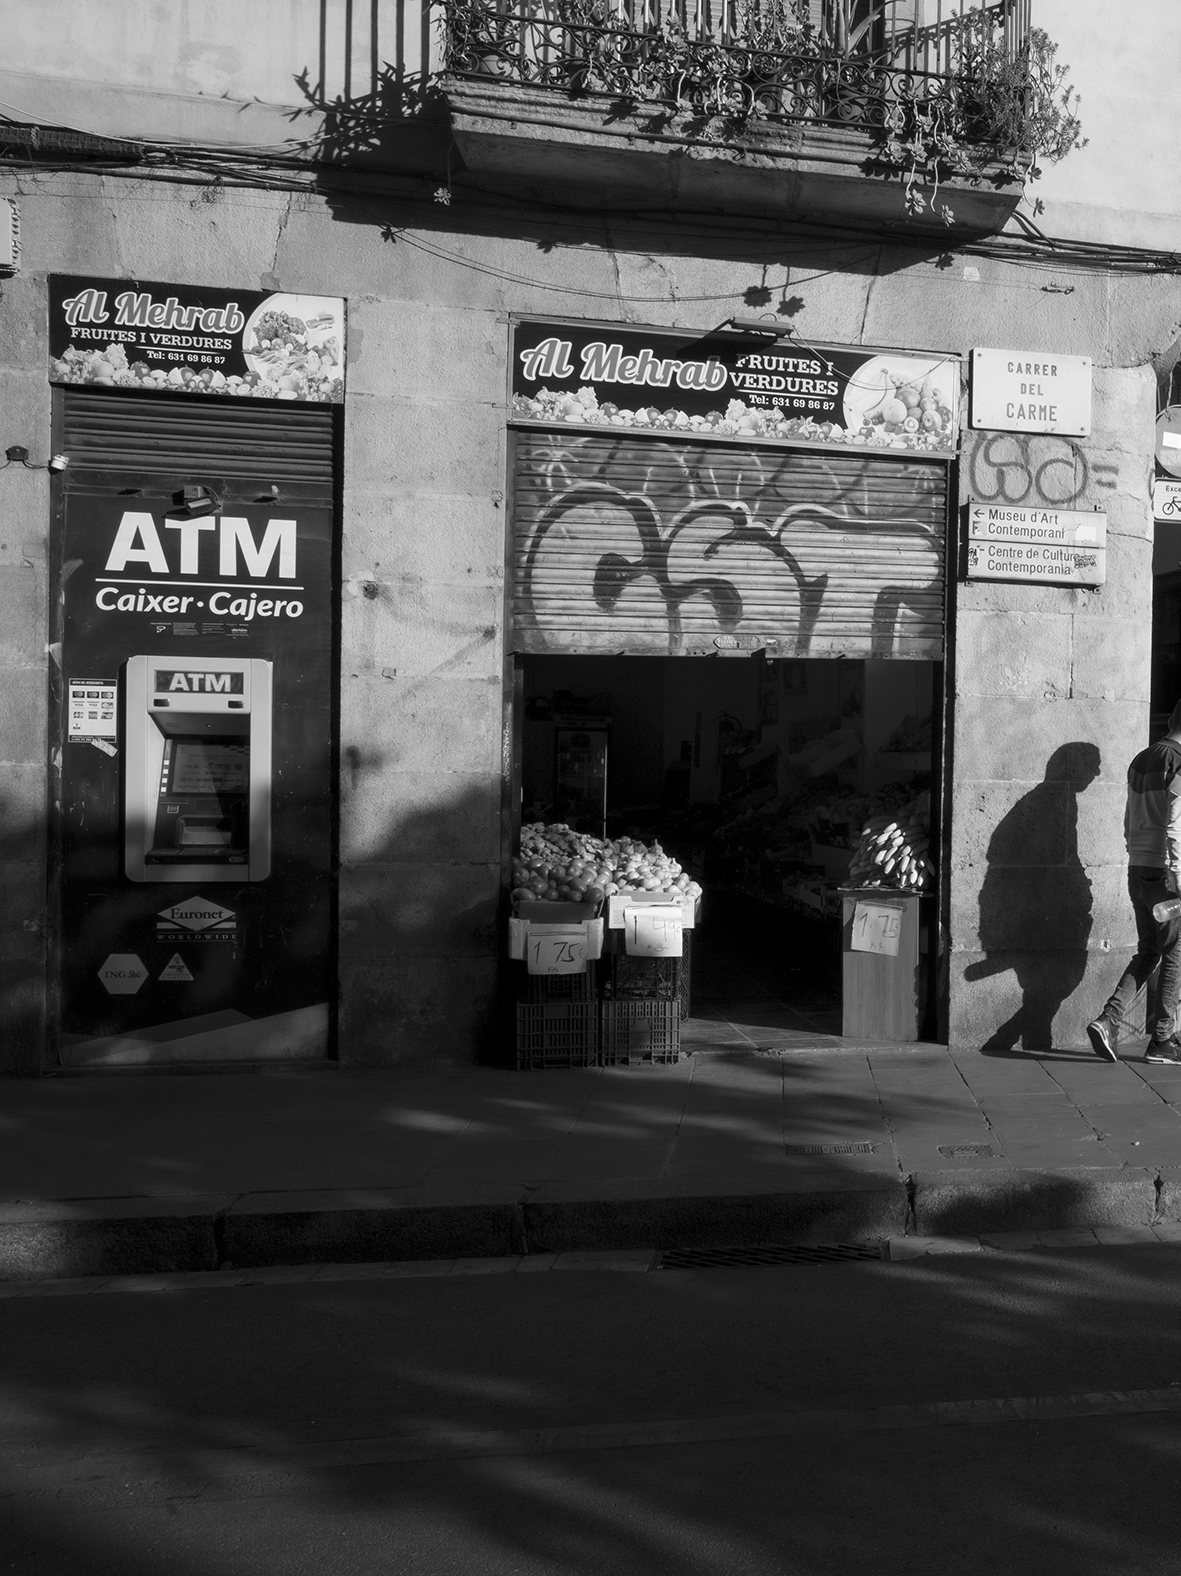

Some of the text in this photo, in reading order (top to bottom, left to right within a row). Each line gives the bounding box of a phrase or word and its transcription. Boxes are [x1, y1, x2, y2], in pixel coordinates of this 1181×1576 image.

[63, 288, 246, 335] Al Mehrab
[71, 327, 234, 350] FRUITES I VERDURES
[148, 351, 228, 365] Tel: 631 69 86 87
[520, 337, 729, 392] Al Mehrab
[735, 354, 834, 376] FRUITES I
[1007, 362, 1058, 377] CARRER
[729, 372, 839, 396] VERDURES
[1020, 383, 1045, 396] DEL
[749, 395, 836, 411] Tel: 631 69 86 87
[1006, 403, 1058, 422] CARME
[988, 509, 1059, 525] Museu d'Art
[988, 523, 1065, 539] Contemporani
[104, 511, 297, 579] ATM
[988, 545, 1023, 559] Centre
[95, 587, 304, 621] Caixer Cajero
[170, 673, 232, 692] ATM
[170, 908, 224, 920] Euronet
[105, 971, 126, 979] ING
